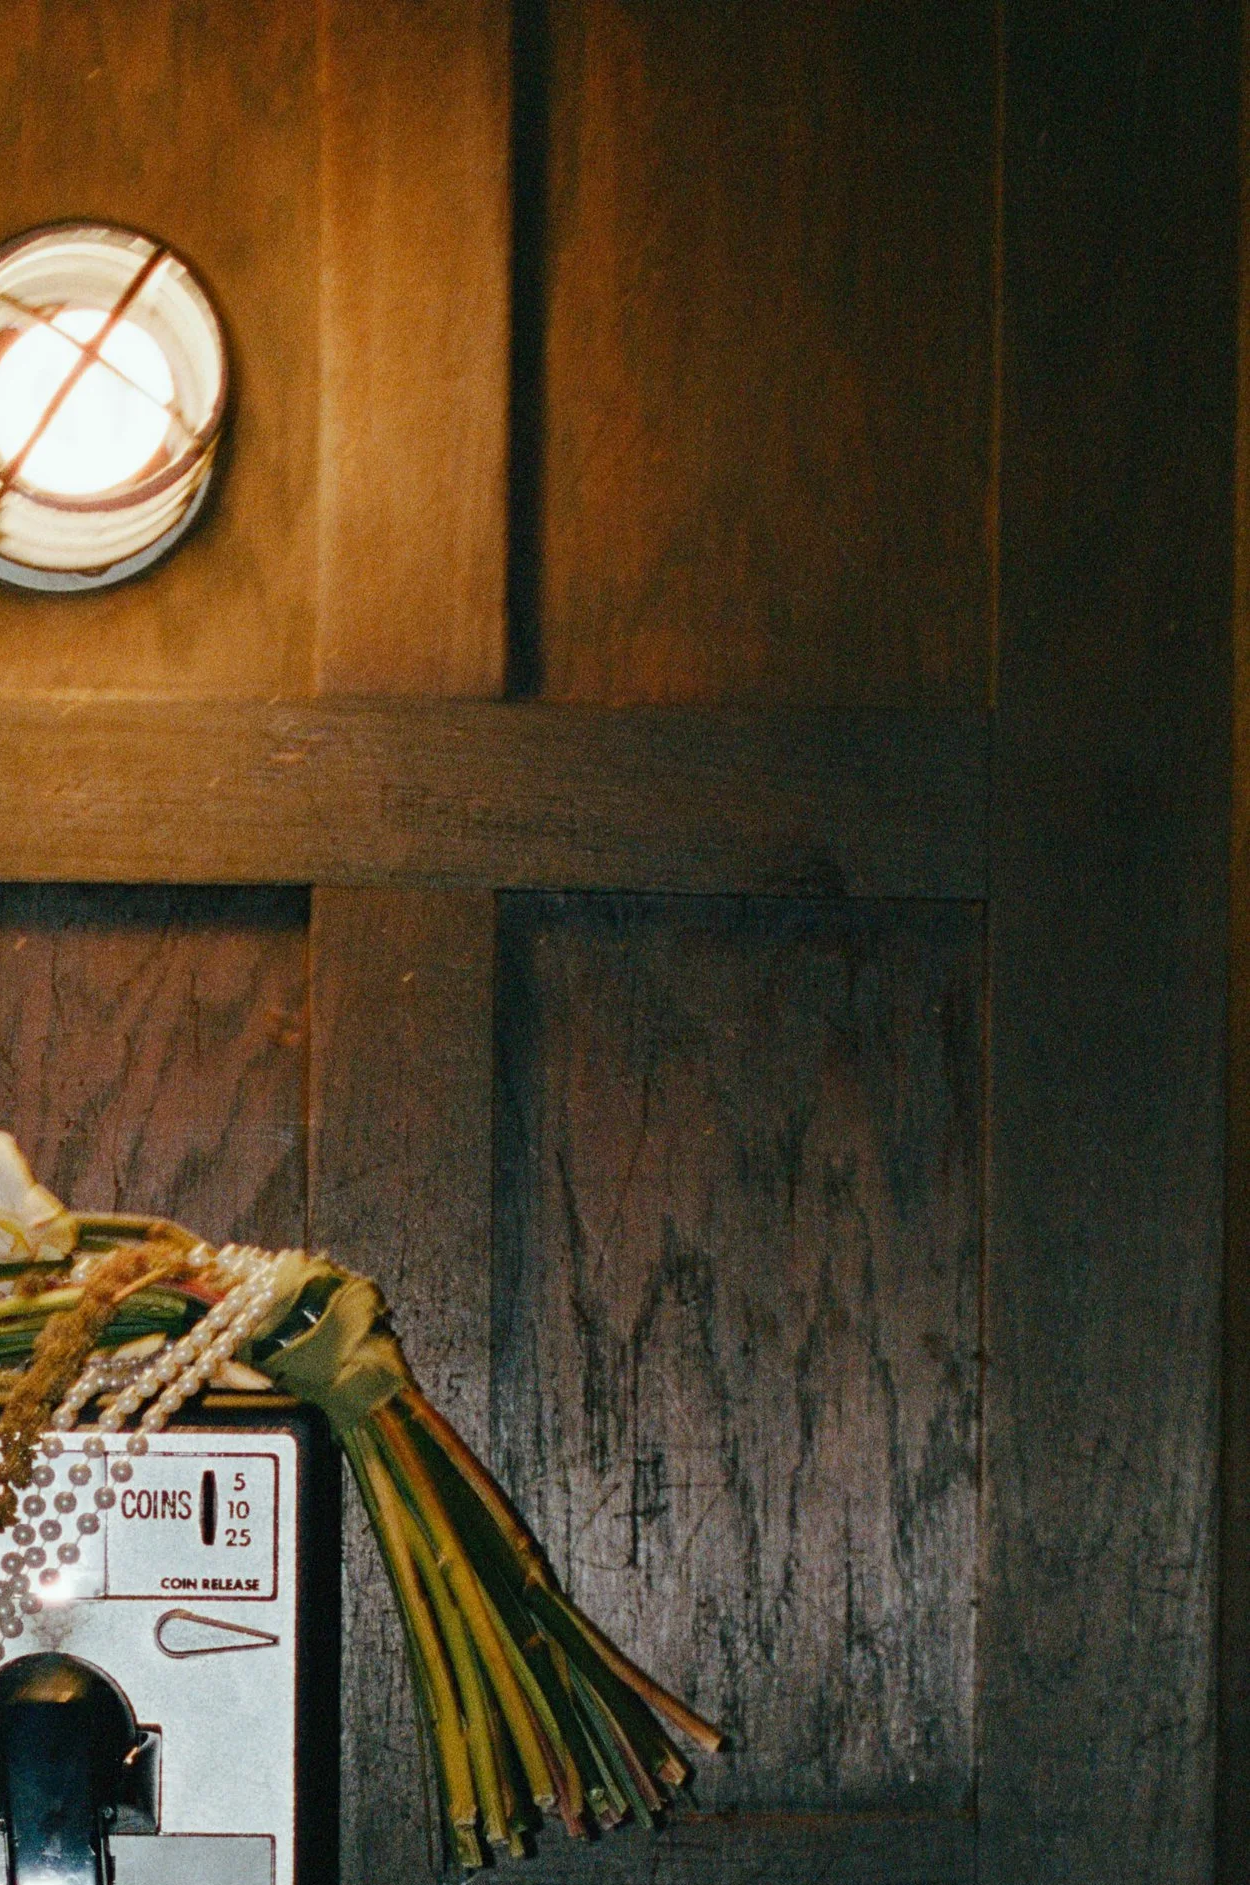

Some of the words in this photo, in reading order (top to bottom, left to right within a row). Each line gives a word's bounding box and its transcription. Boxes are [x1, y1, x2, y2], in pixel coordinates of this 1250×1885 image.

[233, 1472, 246, 1491] 5
[120, 1489, 192, 1520] COINS
[227, 1500, 251, 1520] 10
[224, 1528, 252, 1547] 25
[160, 1577, 198, 1590] COIN
[201, 1578, 261, 1591] RELEASE
